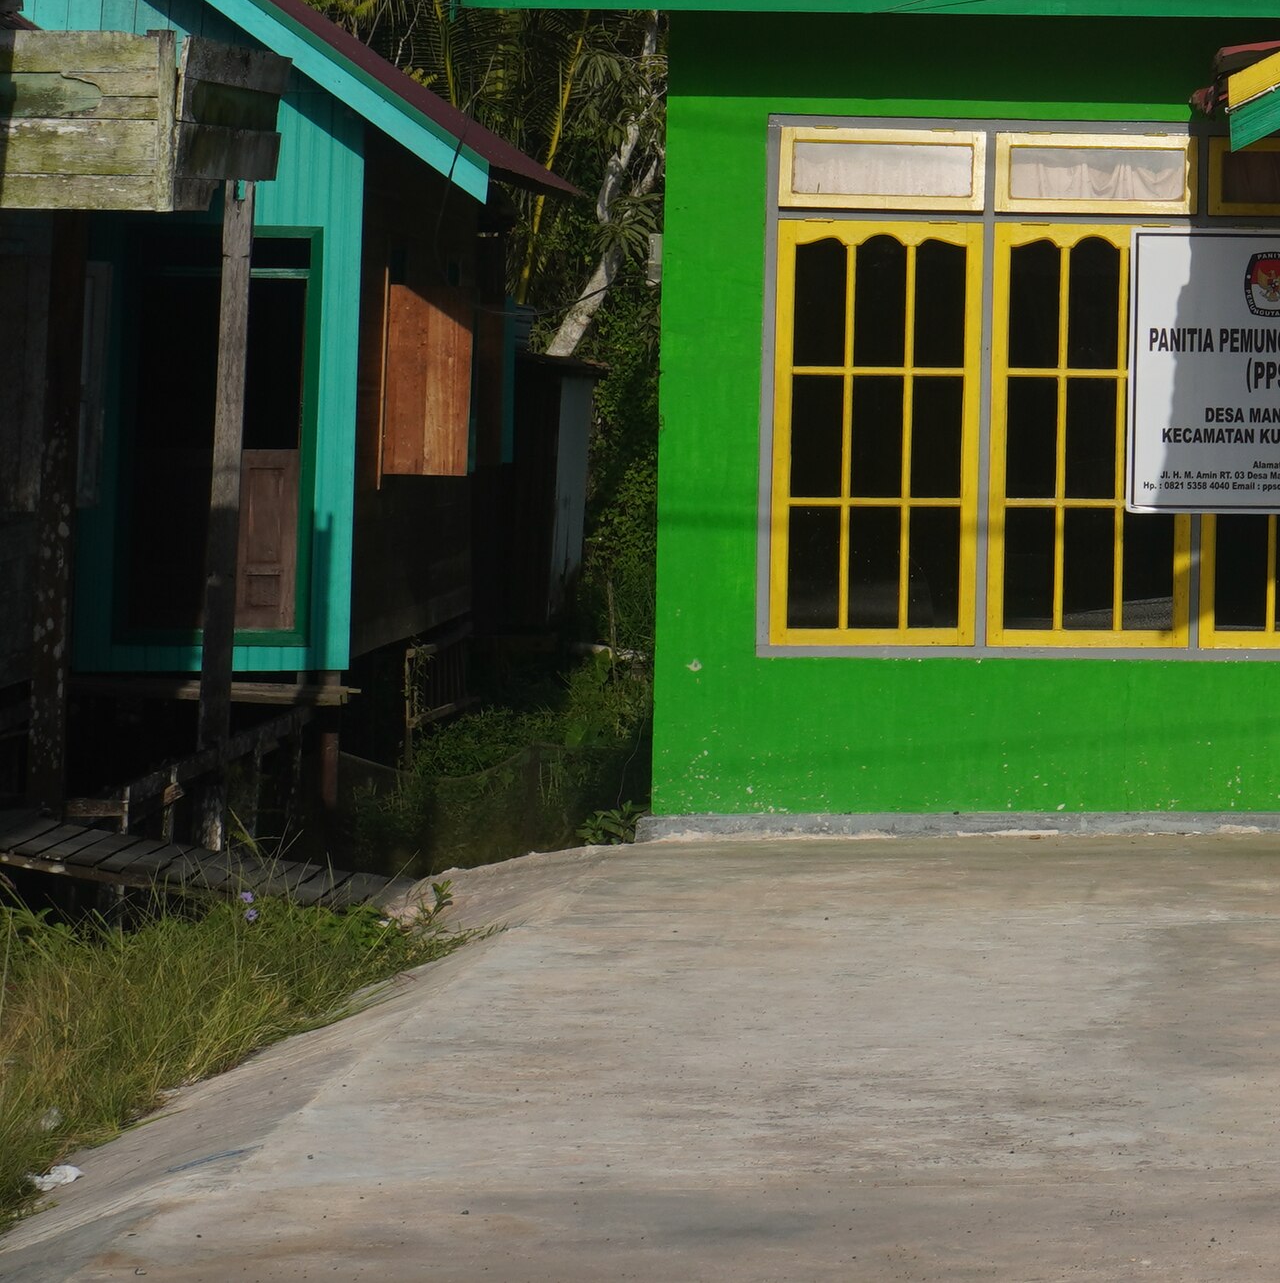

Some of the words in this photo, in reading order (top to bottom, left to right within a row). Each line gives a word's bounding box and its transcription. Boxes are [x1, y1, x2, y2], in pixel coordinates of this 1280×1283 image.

[1149, 328, 1214, 353] PANITIA
[1205, 408, 1245, 423] DESA
[1162, 428, 1255, 444] KECAMATAN
[1160, 471, 1170, 479] Jl.
[1173, 471, 1181, 479] H.
[1184, 471, 1194, 479] M.
[1196, 471, 1217, 479] Amin
[1220, 471, 1232, 479] RT.
[1234, 471, 1245, 479] 03
[1247, 471, 1268, 479] Desa
[1143, 481, 1157, 491] Hp.
[1164, 481, 1184, 490] 0821
[1187, 481, 1207, 490] 5358
[1209, 481, 1230, 490] 4040
[1232, 481, 1255, 490] Email
